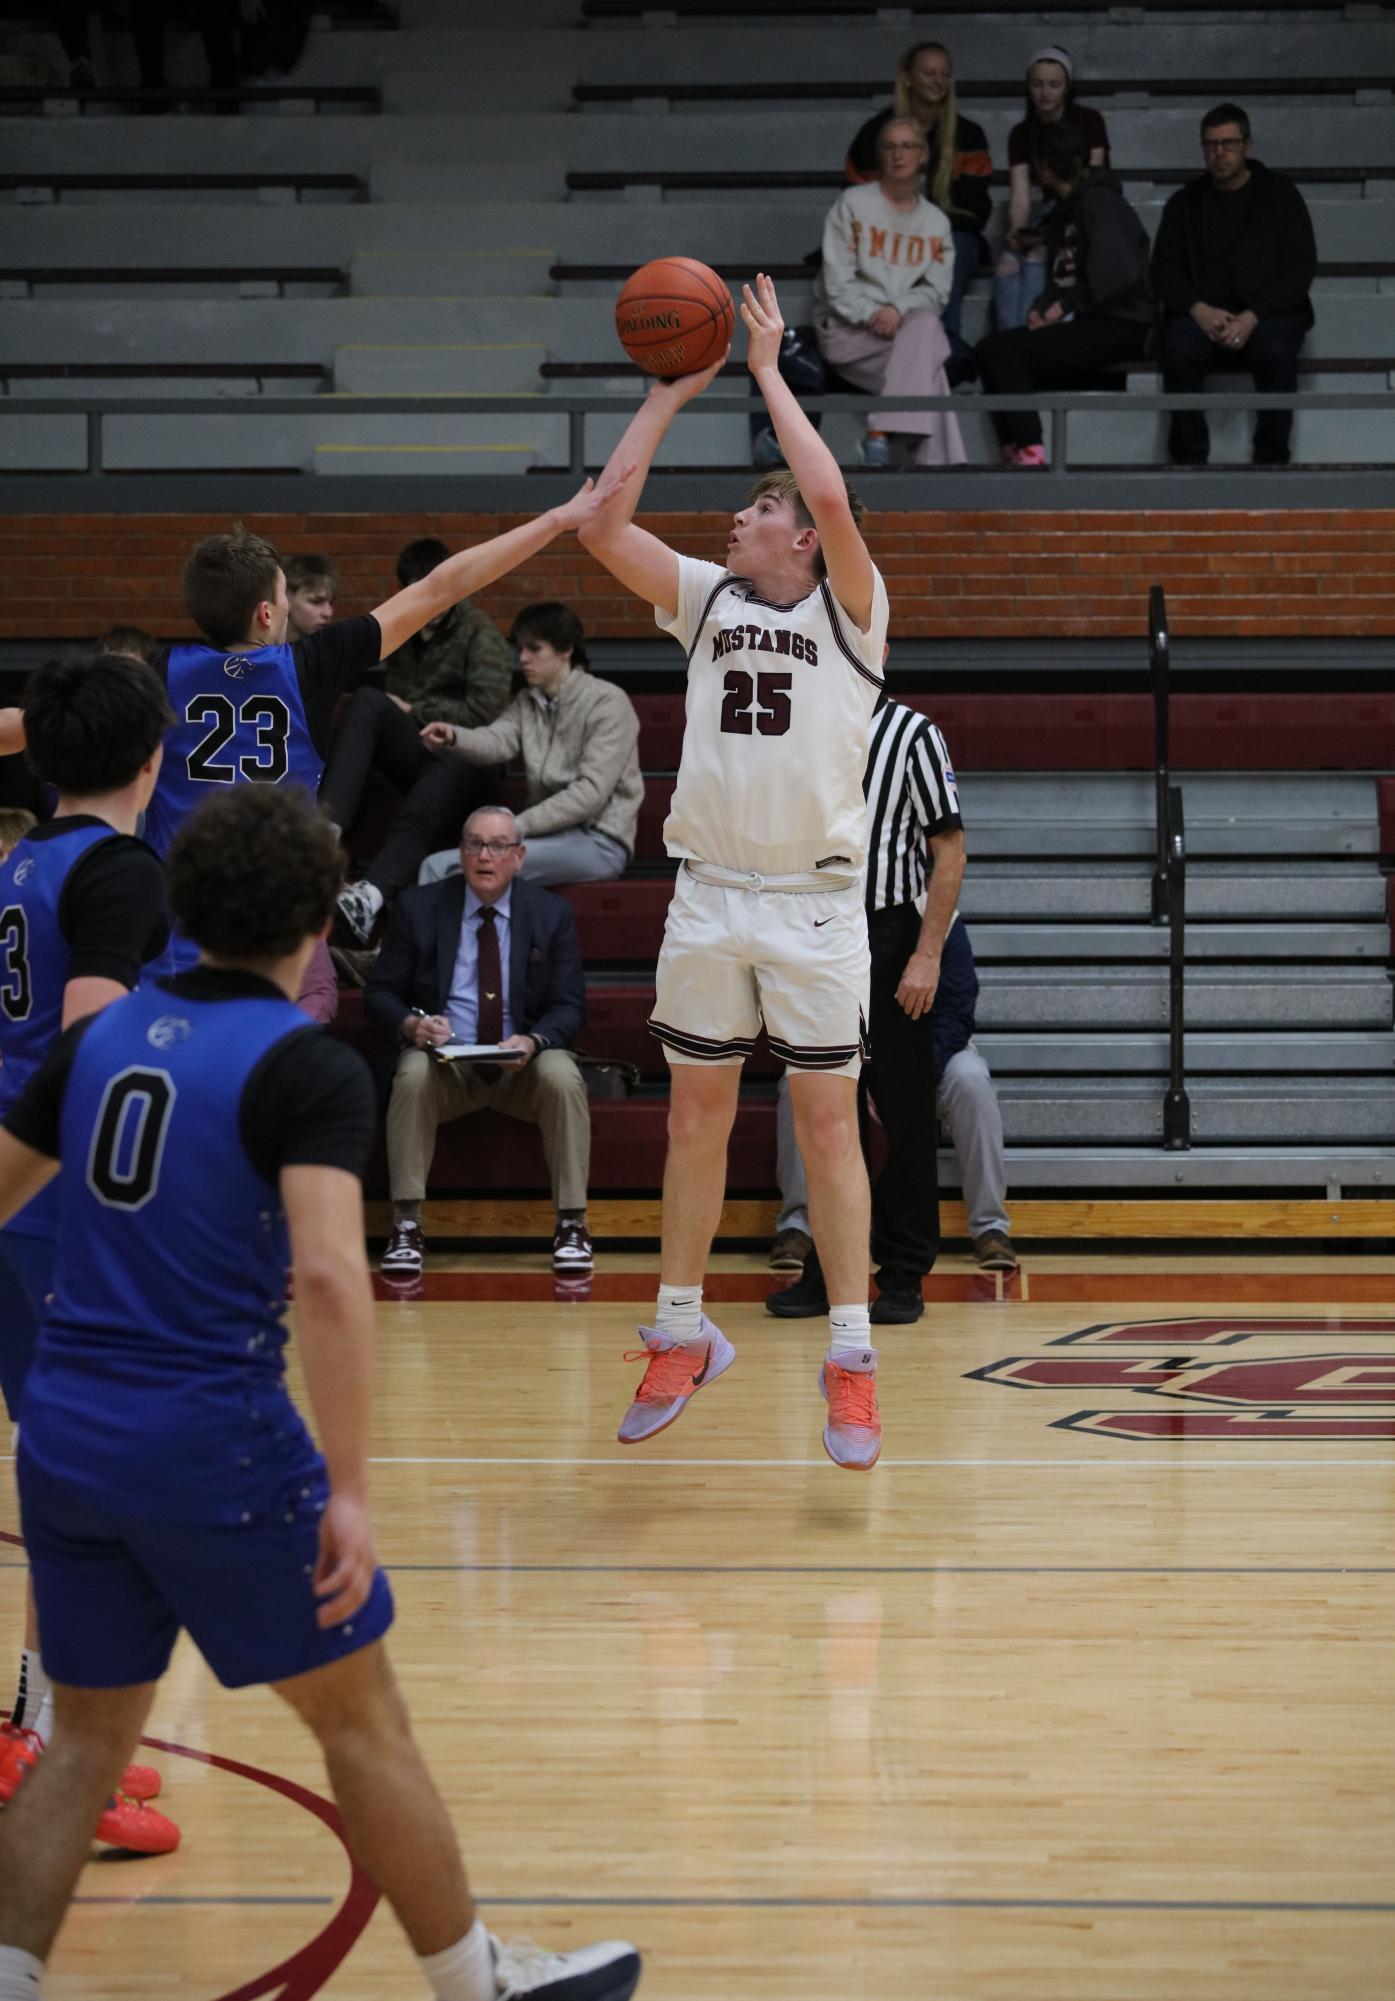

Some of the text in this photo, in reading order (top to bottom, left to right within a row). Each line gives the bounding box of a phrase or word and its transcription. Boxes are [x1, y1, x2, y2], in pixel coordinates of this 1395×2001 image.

[711, 624, 818, 667] MUSTANGS
[185, 693, 291, 784] 23
[720, 670, 792, 736] 25
[0, 904, 33, 1022] 3
[86, 1064, 177, 1212] 0
